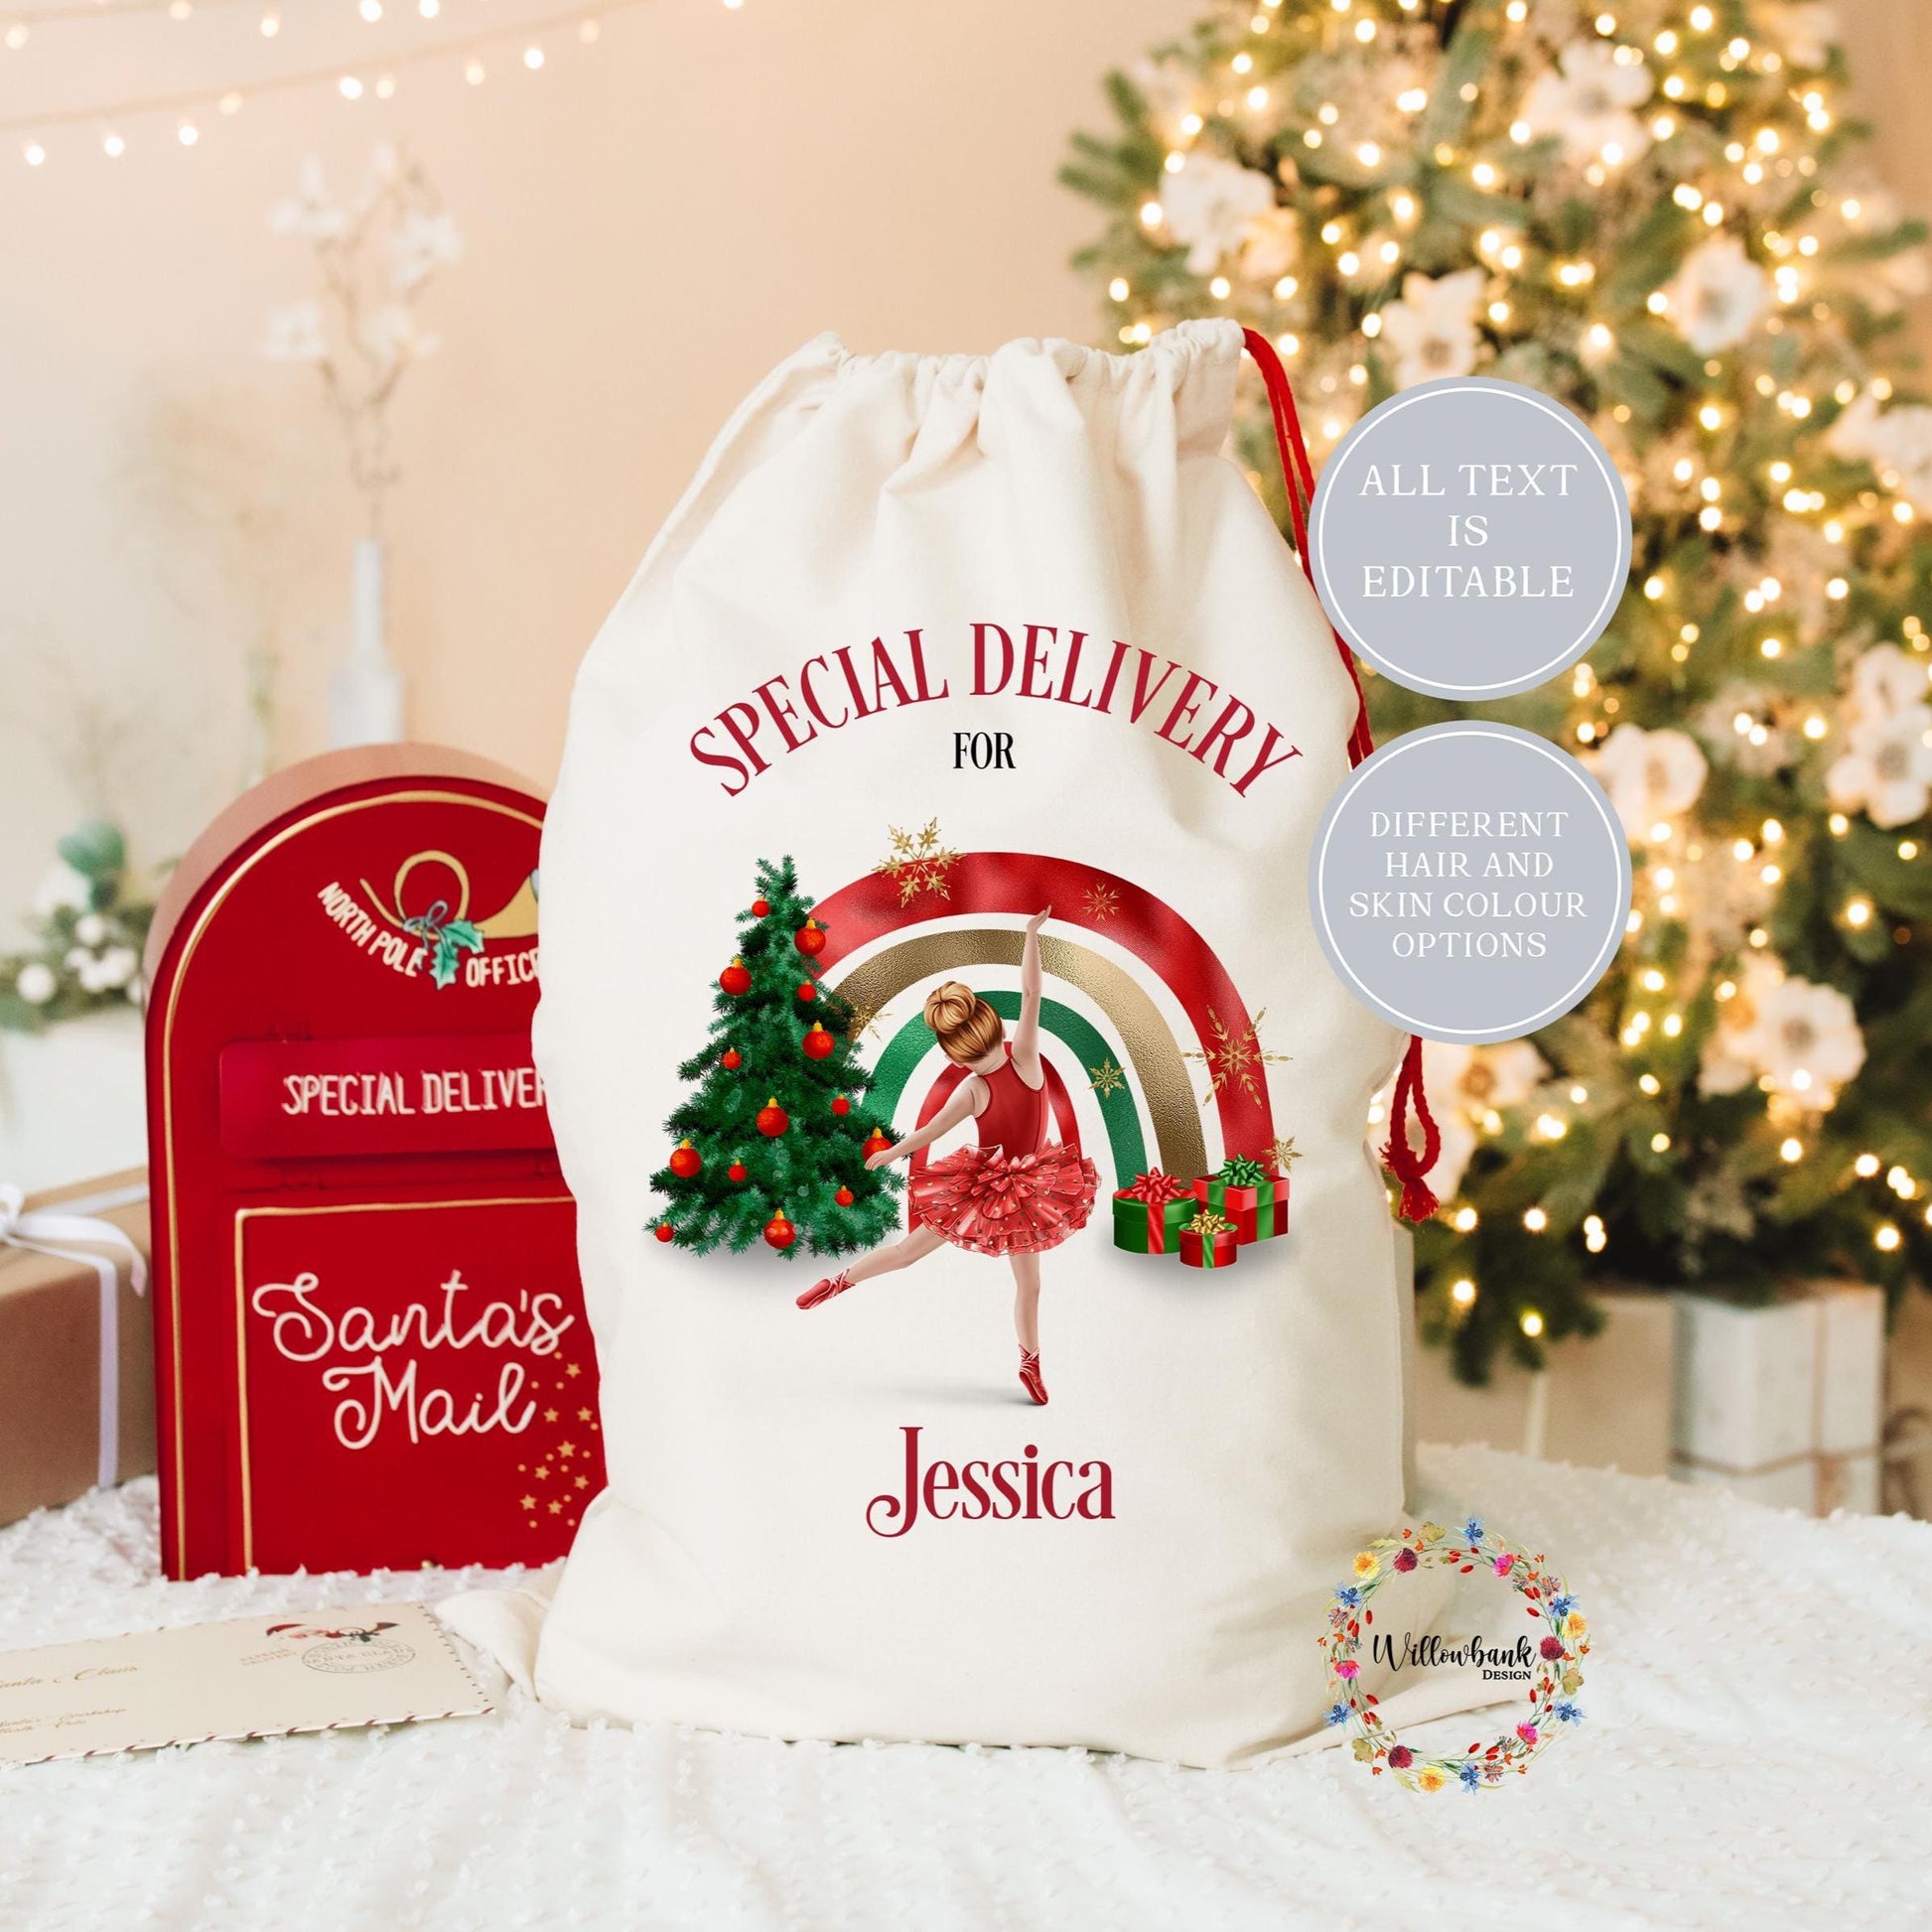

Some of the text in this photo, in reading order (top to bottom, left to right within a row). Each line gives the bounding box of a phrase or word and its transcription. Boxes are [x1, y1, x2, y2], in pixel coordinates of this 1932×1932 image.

[690, 623, 1304, 798] SPECIAL DELIVERY
[952, 732, 1017, 770] FOR
[318, 882, 377, 948] NORTH
[367, 930, 428, 978] POLE
[282, 1072, 416, 1116] SPECIAL
[252, 1269, 575, 1362] Santa's
[323, 1355, 537, 1449] Mail
[866, 1427, 1116, 1538] Jessica
